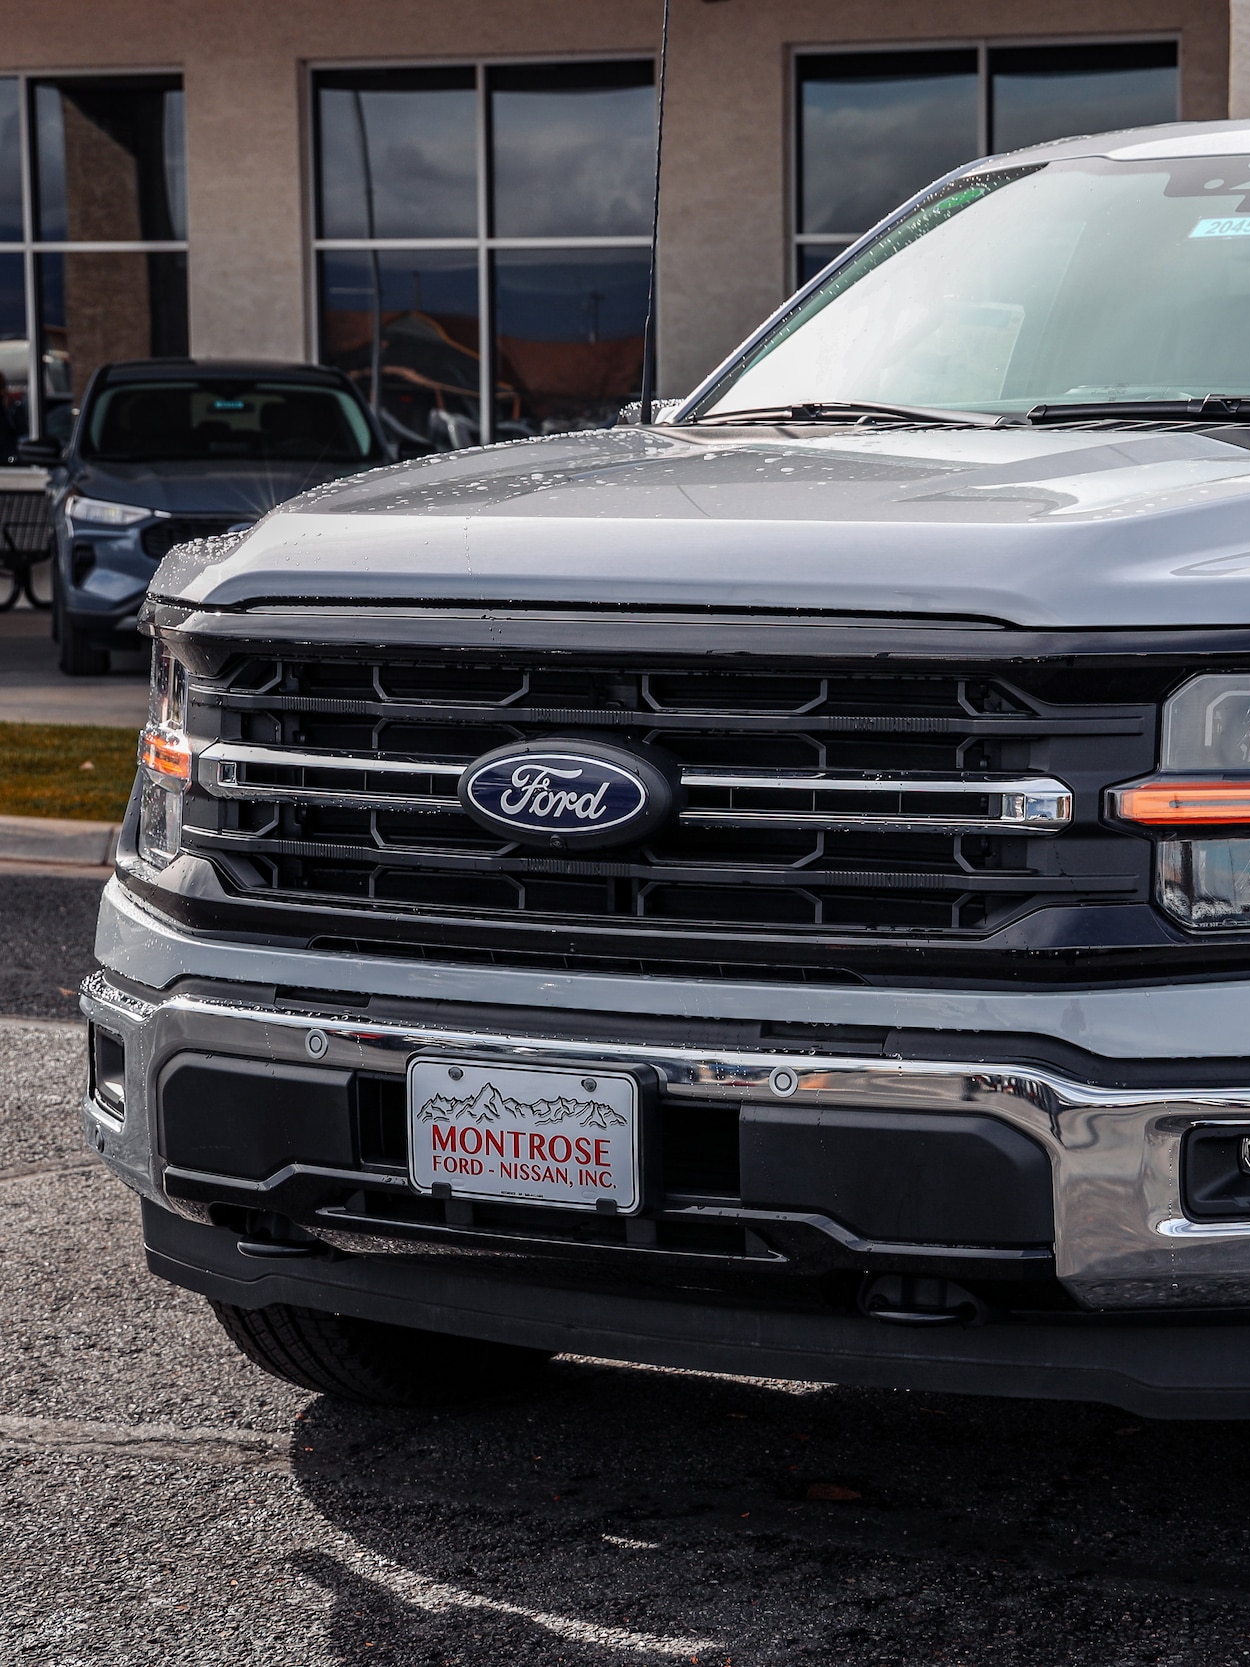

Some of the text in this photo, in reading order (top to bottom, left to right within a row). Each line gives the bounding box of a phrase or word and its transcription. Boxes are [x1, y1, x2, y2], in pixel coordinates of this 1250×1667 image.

[501, 764, 609, 819] Ford
[431, 1124, 612, 1167] MONTROSE
[432, 1155, 484, 1176] FORD
[500, 1162, 574, 1188] NISSAN,
[578, 1169, 617, 1189] INC.
